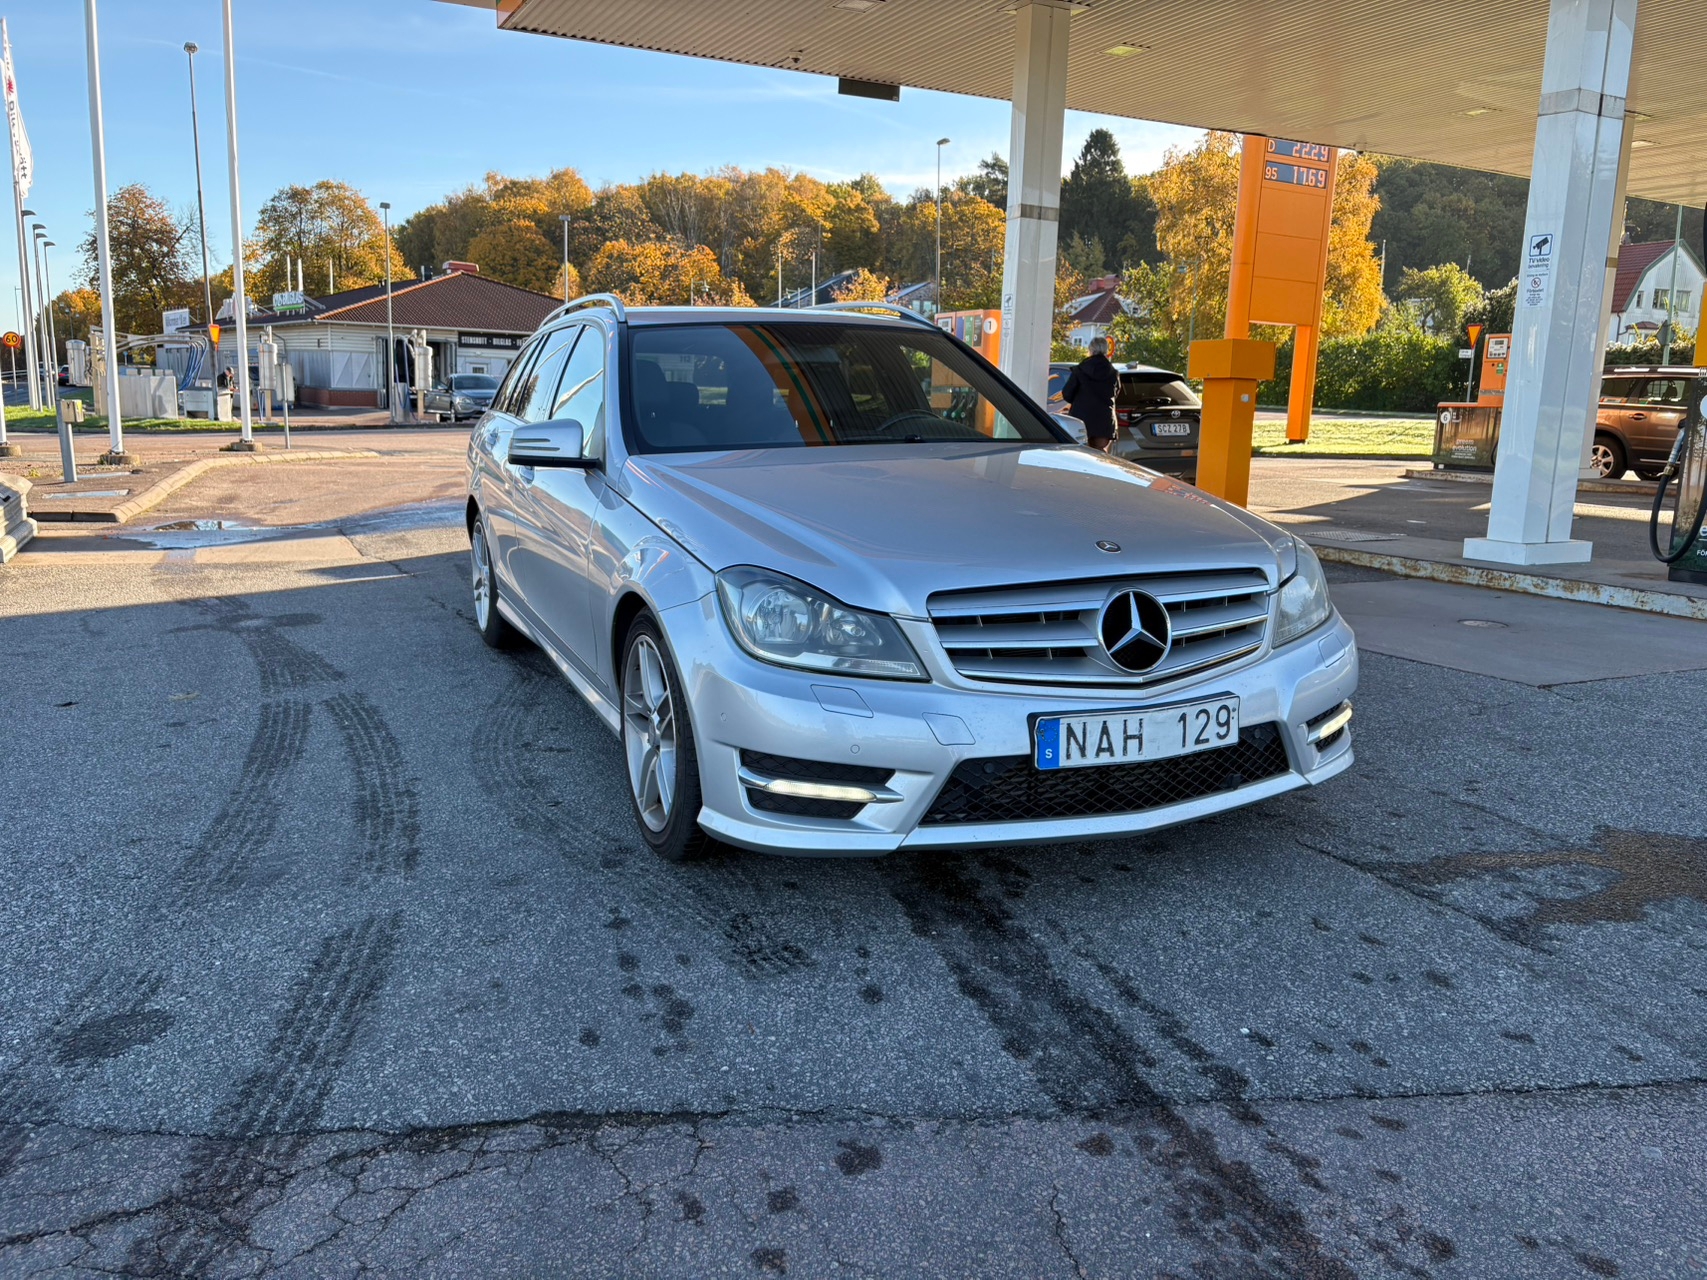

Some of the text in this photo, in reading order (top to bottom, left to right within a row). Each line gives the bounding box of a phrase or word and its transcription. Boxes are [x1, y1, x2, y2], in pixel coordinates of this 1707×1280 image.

[1267, 140, 1276, 152] D
[1265, 166, 1278, 180] 95
[988, 321, 993, 331] 1
[6, 335, 17, 343] 60
[1443, 413, 1448, 422] 6
[1157, 424, 1172, 433] SCZ
[1066, 704, 1231, 760] NAH 129
[1045, 748, 1053, 759] S
